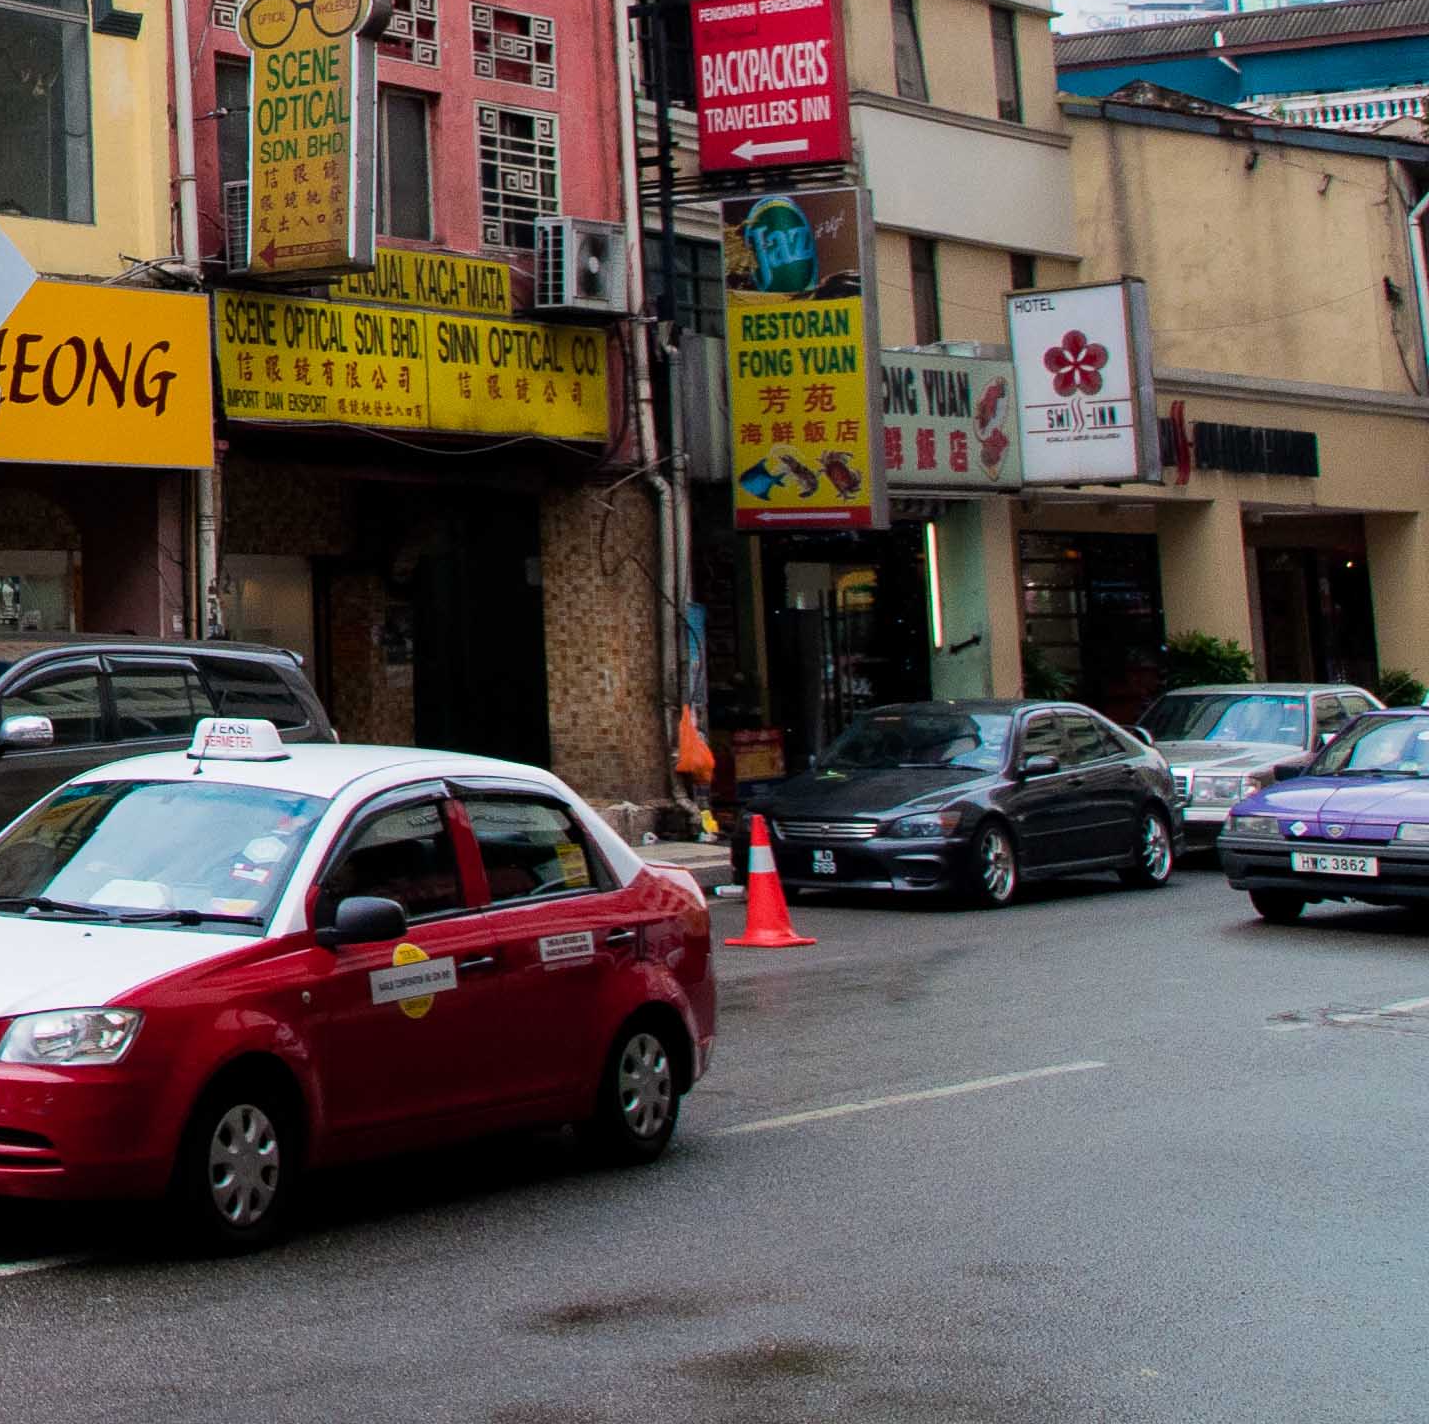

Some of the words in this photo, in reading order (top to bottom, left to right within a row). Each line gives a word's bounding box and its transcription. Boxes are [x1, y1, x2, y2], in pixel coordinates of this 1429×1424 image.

[698, 2, 757, 23] PENGINAPAN
[266, 44, 340, 91] SCENE
[701, 39, 829, 98] BACKPACKERS
[257, 87, 349, 136] OPTICAL
[704, 99, 798, 133] TRAVELLERS
[801, 95, 831, 123] INN
[259, 137, 302, 164] SDN.
[306, 132, 346, 158] BHD.
[413, 257, 507, 311] KACA-MATA
[224, 297, 278, 346] SCENE
[283, 305, 349, 353] OPTICAL
[742, 307, 851, 342] RESTORAN
[1014, 298, 1056, 313] HOTEL
[437, 320, 480, 365] SINN
[487, 326, 564, 373] OPTICAL
[739, 348, 793, 379] FONG
[799, 344, 857, 376] YUAN
[226, 387, 261, 410] IMPORT
[265, 392, 284, 410] DAN
[288, 392, 328, 414] EKSPORT
[922, 368, 972, 418] YUAN
